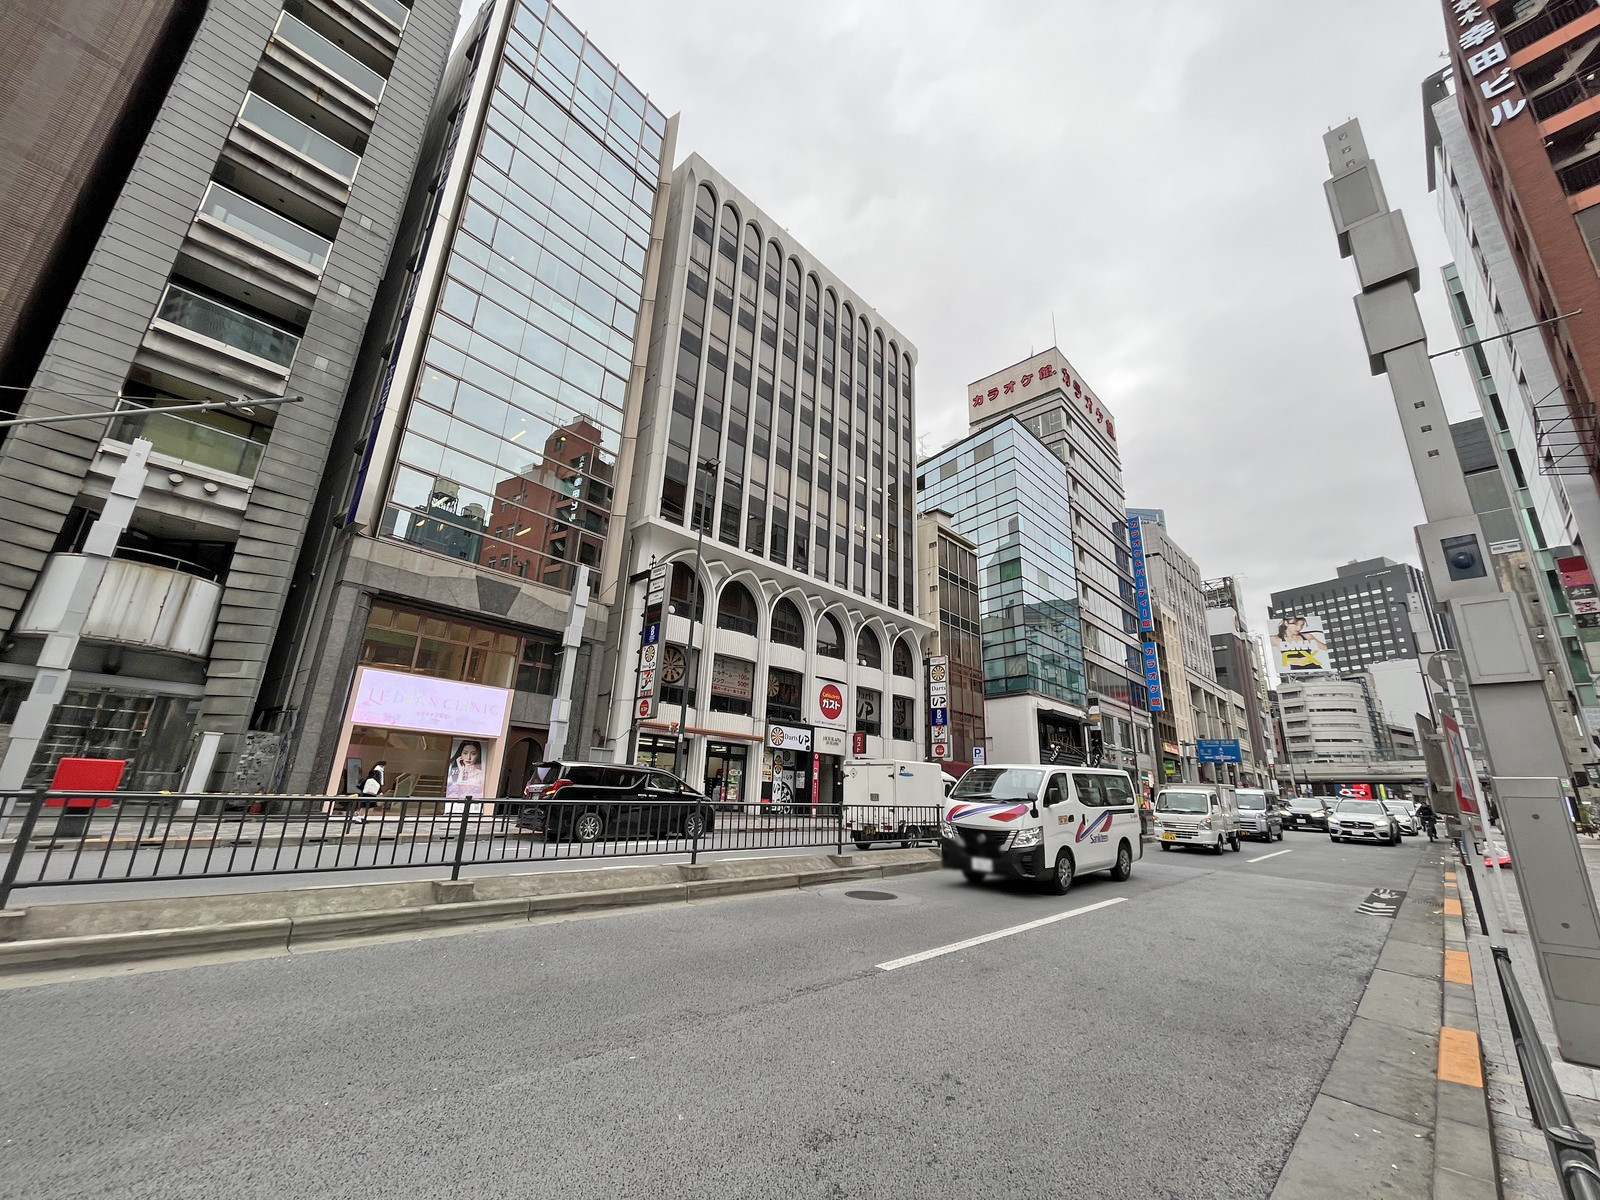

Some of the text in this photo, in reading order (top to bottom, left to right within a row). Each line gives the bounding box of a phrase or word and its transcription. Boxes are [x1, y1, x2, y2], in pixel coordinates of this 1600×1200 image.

[1451, 0, 1526, 127] 本木幸田ビル
[972, 364, 1054, 408] カラオケ館
[1061, 367, 1117, 442] カラオケ館
[1281, 649, 1323, 667] FX
[1144, 646, 1161, 707] カラオケ館
[443, 698, 500, 715] CLINIC
[822, 698, 841, 710] ガスト
[933, 696, 946, 706] UP
[784, 733, 810, 744] Darts UP
[974, 748, 981, 757] P
